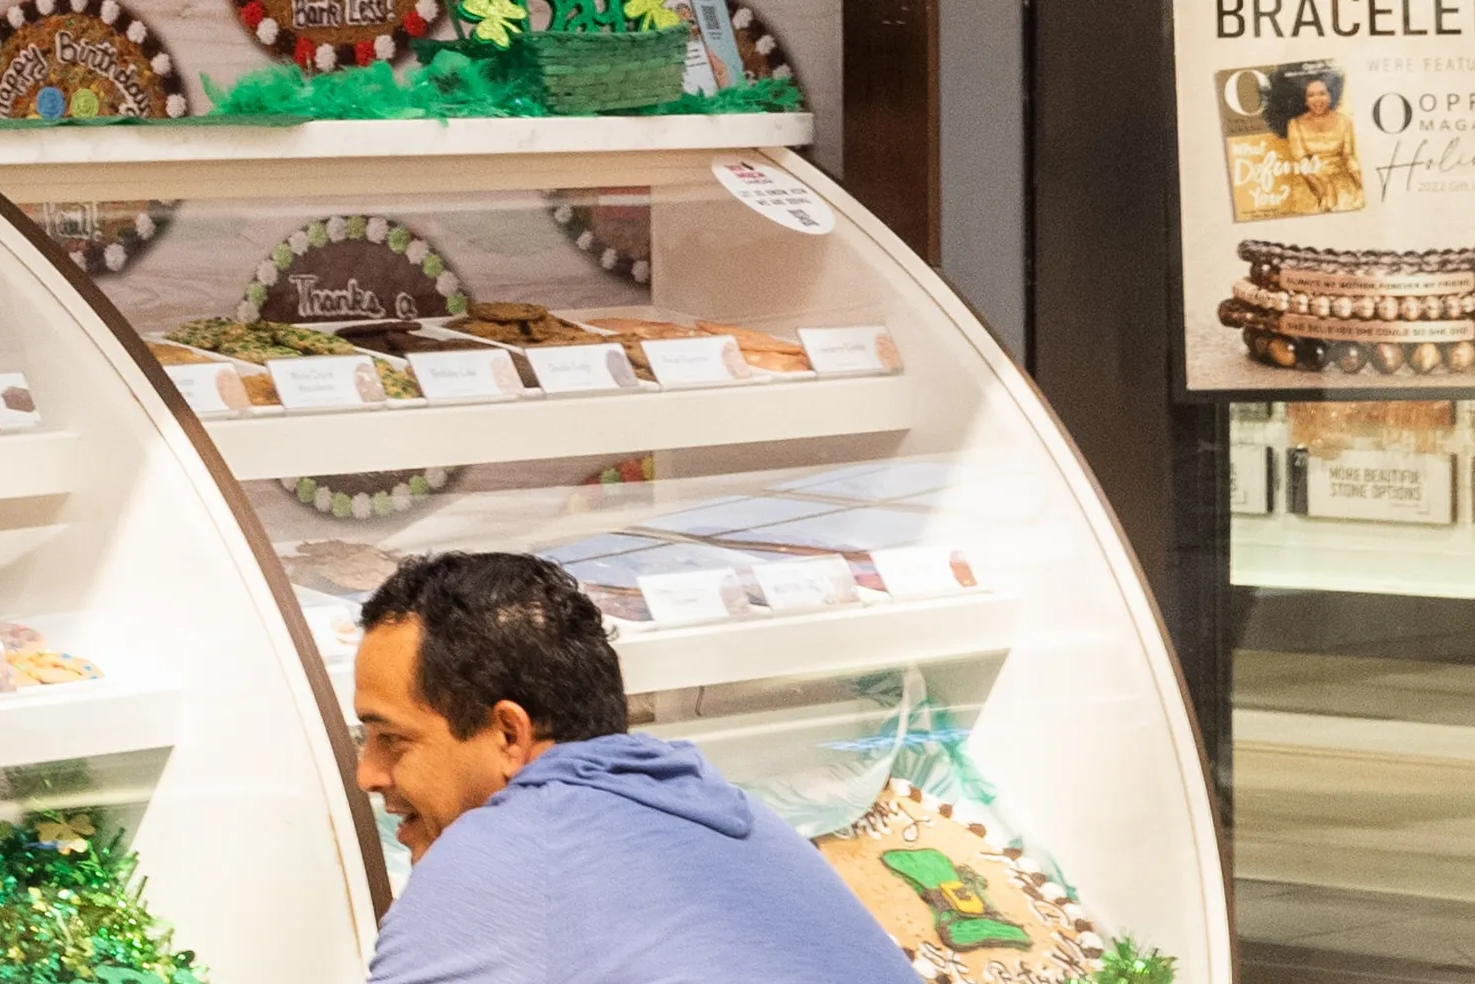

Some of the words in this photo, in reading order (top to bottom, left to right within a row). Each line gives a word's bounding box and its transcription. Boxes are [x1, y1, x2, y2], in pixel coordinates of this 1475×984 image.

[1217, 0, 1475, 38] BRACELE
[1367, 57, 1414, 72] WERE
[289, 274, 385, 319] Thanks
[394, 293, 417, 319] a
[1330, 467, 1361, 481] MORE
[1330, 482, 1367, 499] STONE
[1369, 484, 1422, 501] OPTIONS
